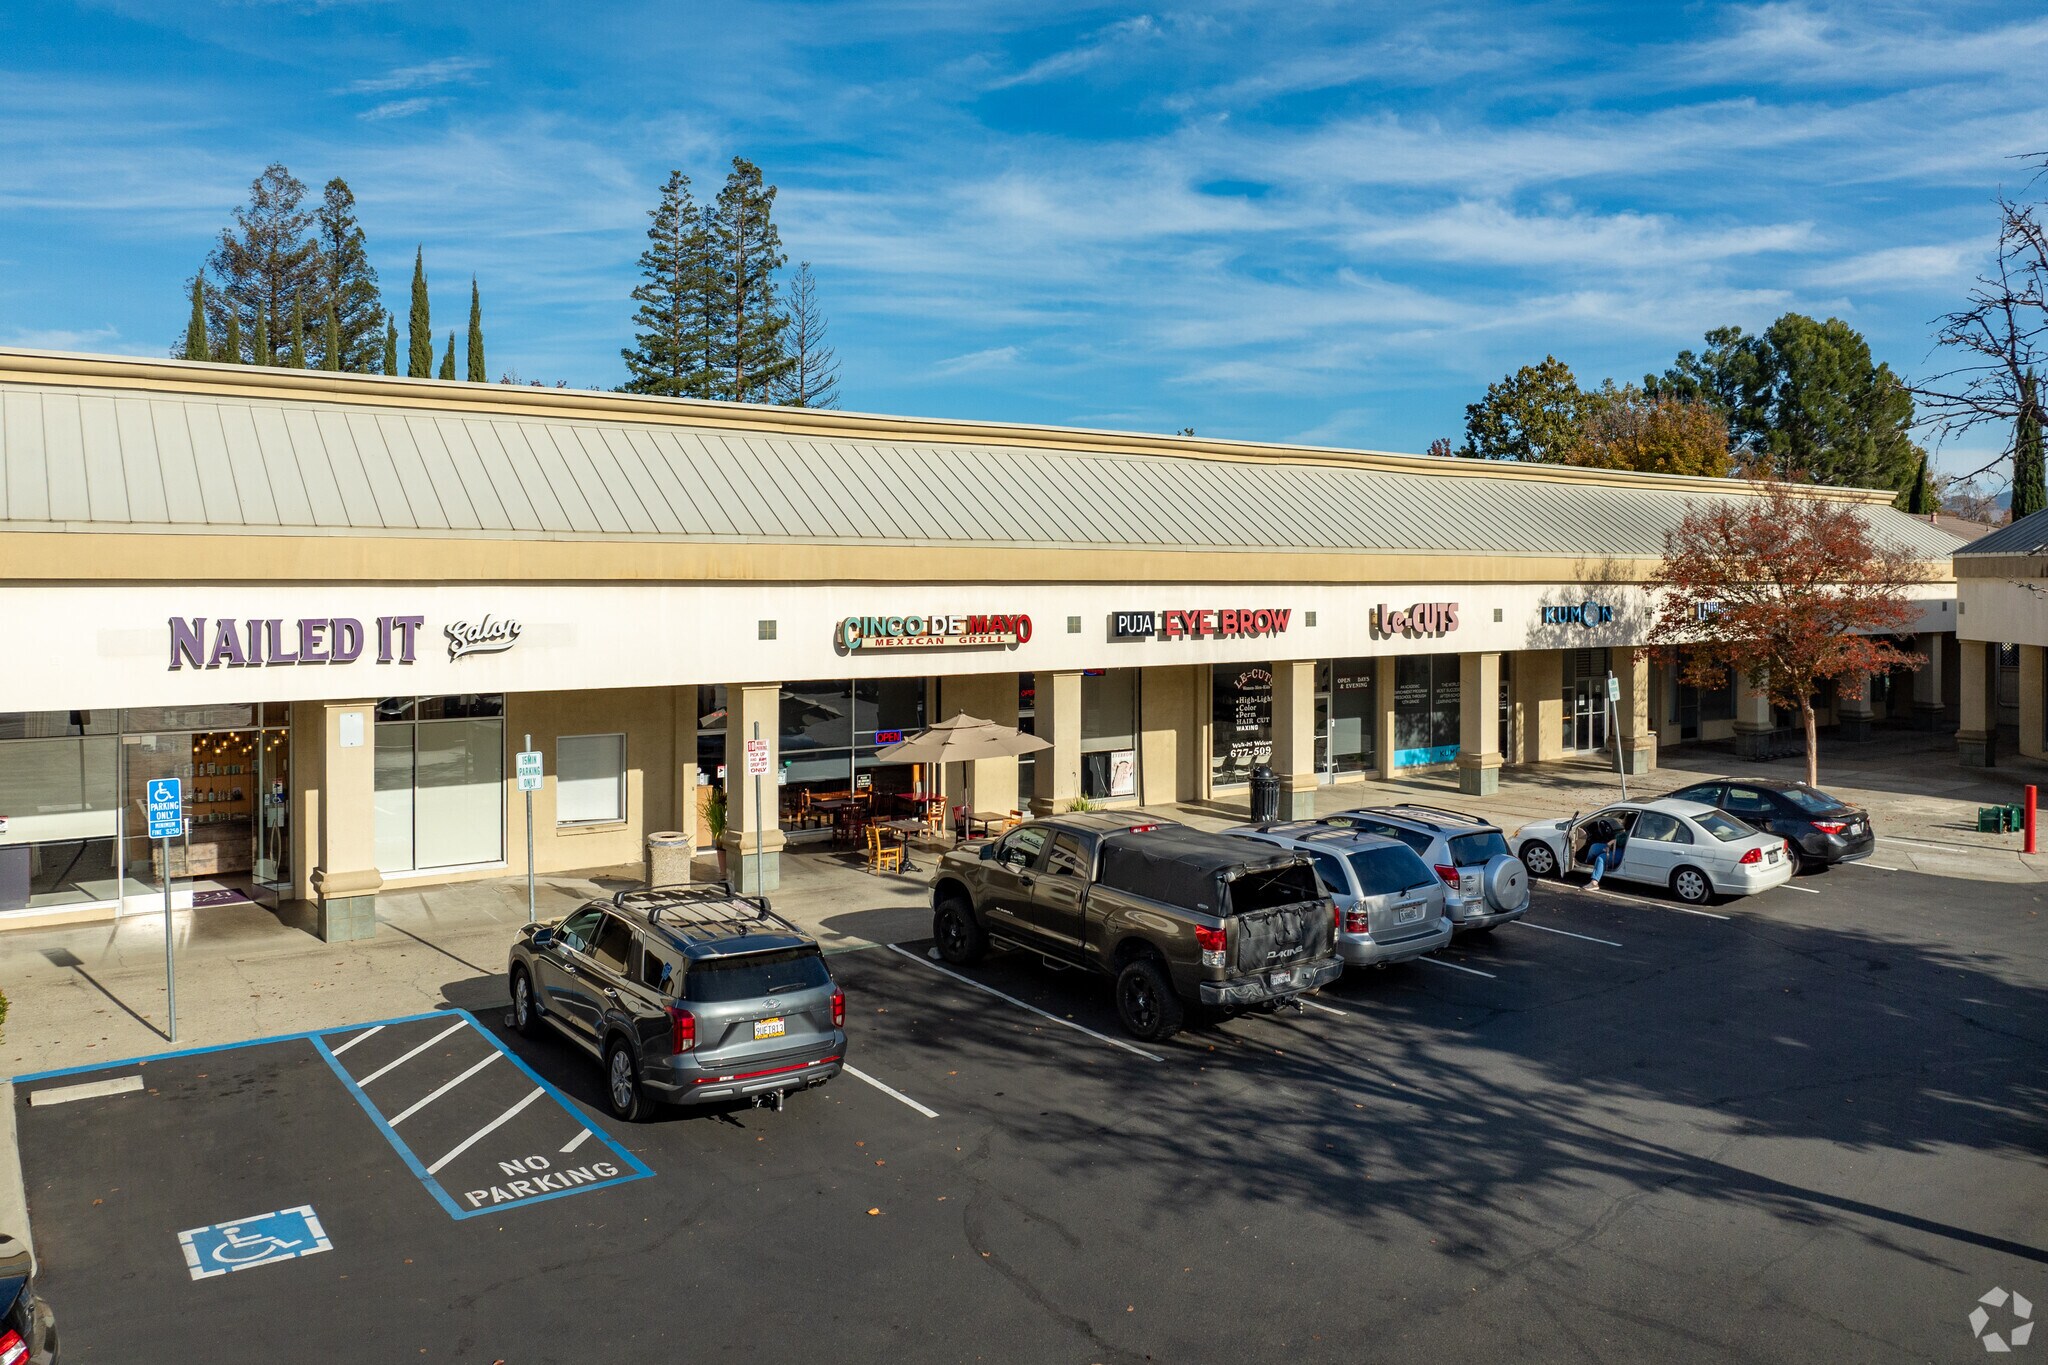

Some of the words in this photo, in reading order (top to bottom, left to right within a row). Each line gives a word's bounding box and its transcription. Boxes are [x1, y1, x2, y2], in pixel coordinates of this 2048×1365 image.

[1543, 601, 1613, 628] KUMON
[1118, 615, 1153, 633] PUJA
[1164, 609, 1214, 636] EYE
[1221, 608, 1292, 635] BROW
[844, 616, 924, 649] CINCO
[930, 615, 962, 634] DE
[968, 613, 1033, 644] MAYO
[168, 617, 364, 670] NAILED
[376, 615, 424, 664] IT
[443, 614, 522, 662] Salon
[875, 637, 945, 647] MEXICAN
[958, 635, 1005, 644] GRILL
[1239, 704, 1257, 712] Color
[1236, 724, 1259, 732] WAXING
[877, 731, 900, 743] OPEN
[1230, 746, 1272, 758] 677-509
[1440, 747, 1460, 757] KUM
[518, 766, 541, 777] PARKING
[150, 801, 179, 812] PARKING
[156, 810, 174, 820] ONLY
[1266, 944, 1304, 960] DAKINE
[498, 1155, 550, 1177] NO
[464, 1162, 619, 1207] PARKING
